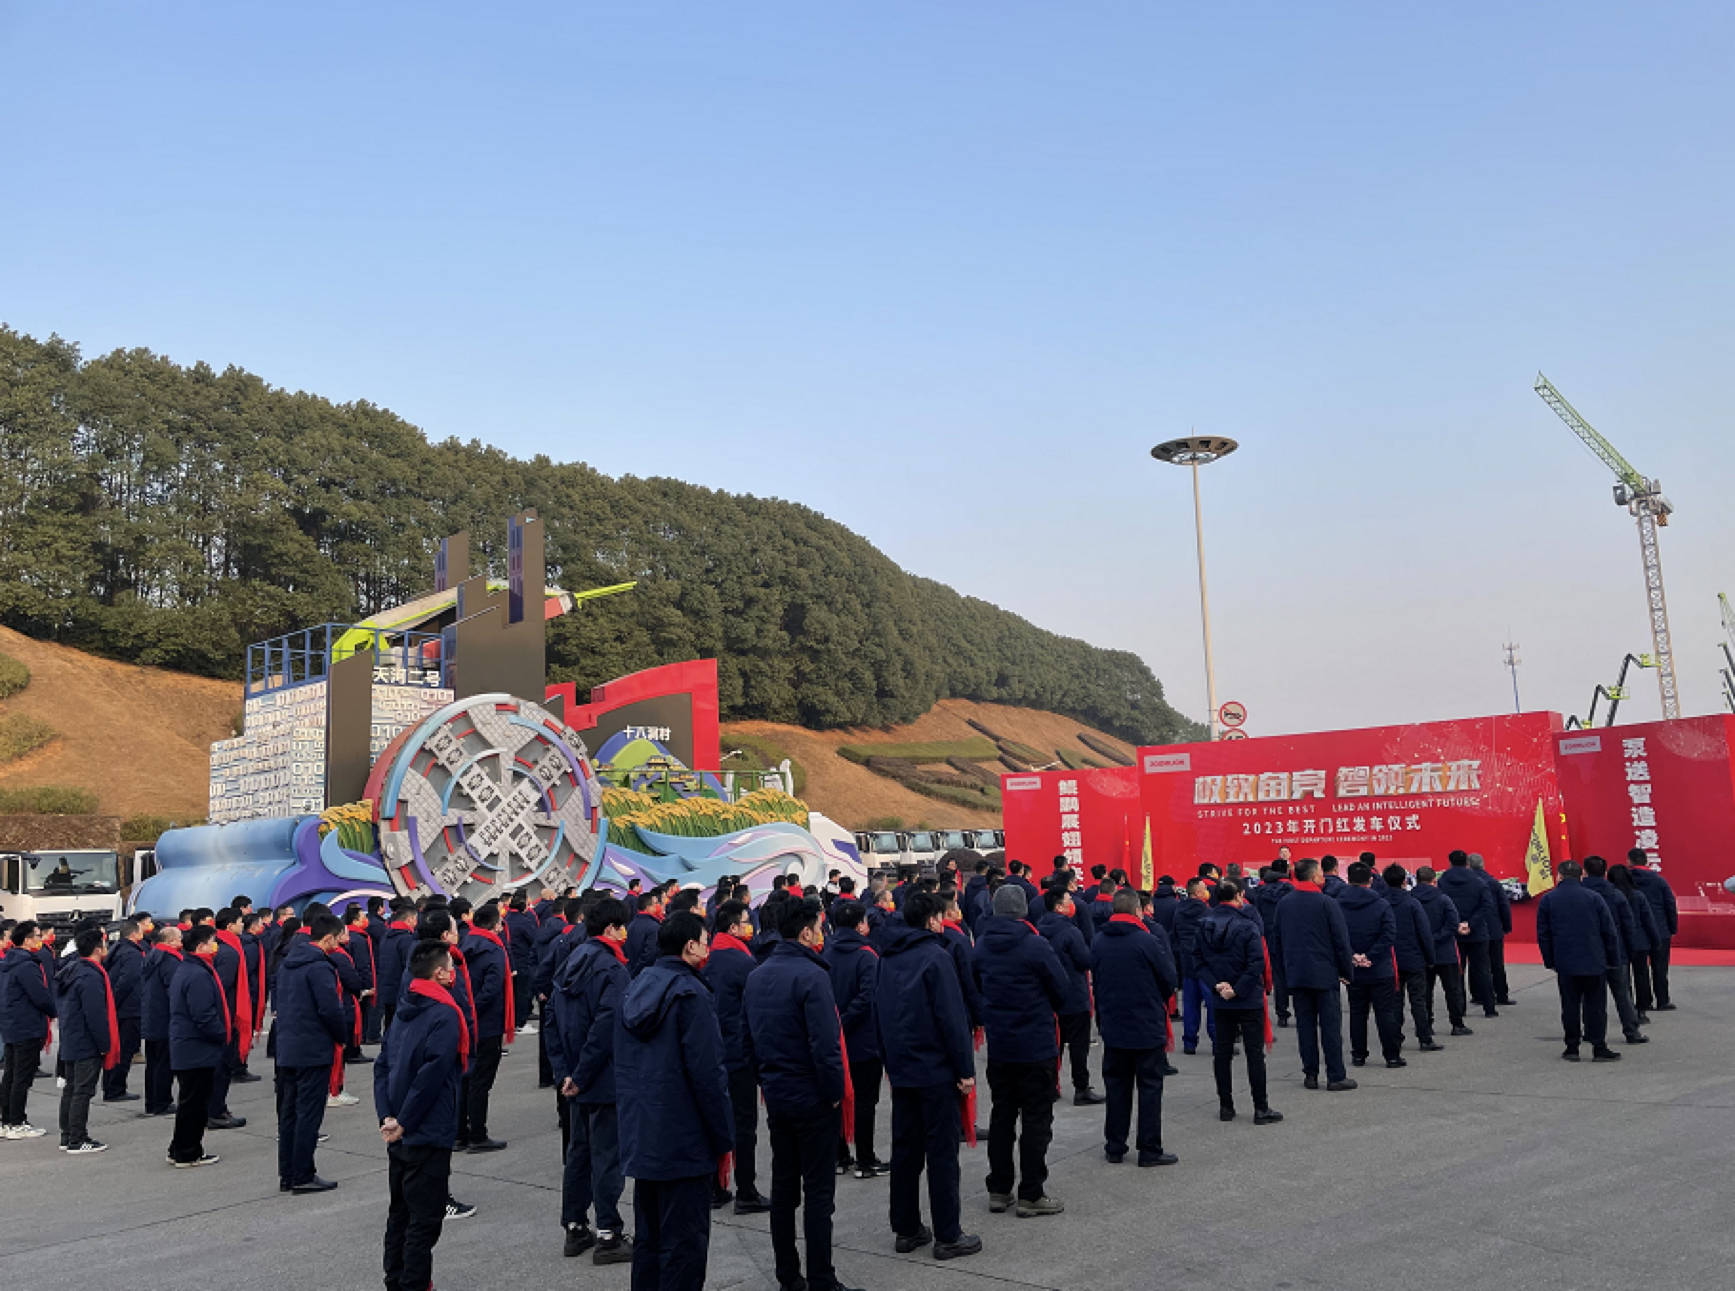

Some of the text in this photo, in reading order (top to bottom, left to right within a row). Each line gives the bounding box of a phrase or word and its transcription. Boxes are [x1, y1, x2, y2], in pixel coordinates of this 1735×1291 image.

[1334, 759, 1482, 798] 智领未来
[1197, 808, 1233, 818] STRIVE
[1238, 807, 1258, 817] FOR
[1263, 806, 1283, 815] THE
[1288, 804, 1316, 814] BEST
[1332, 802, 1355, 813] LEAD
[1357, 802, 1370, 811] AN
[1372, 798, 1434, 811] INTELLIGENT
[1243, 814, 1421, 834] 2023年开门红发车仪式
